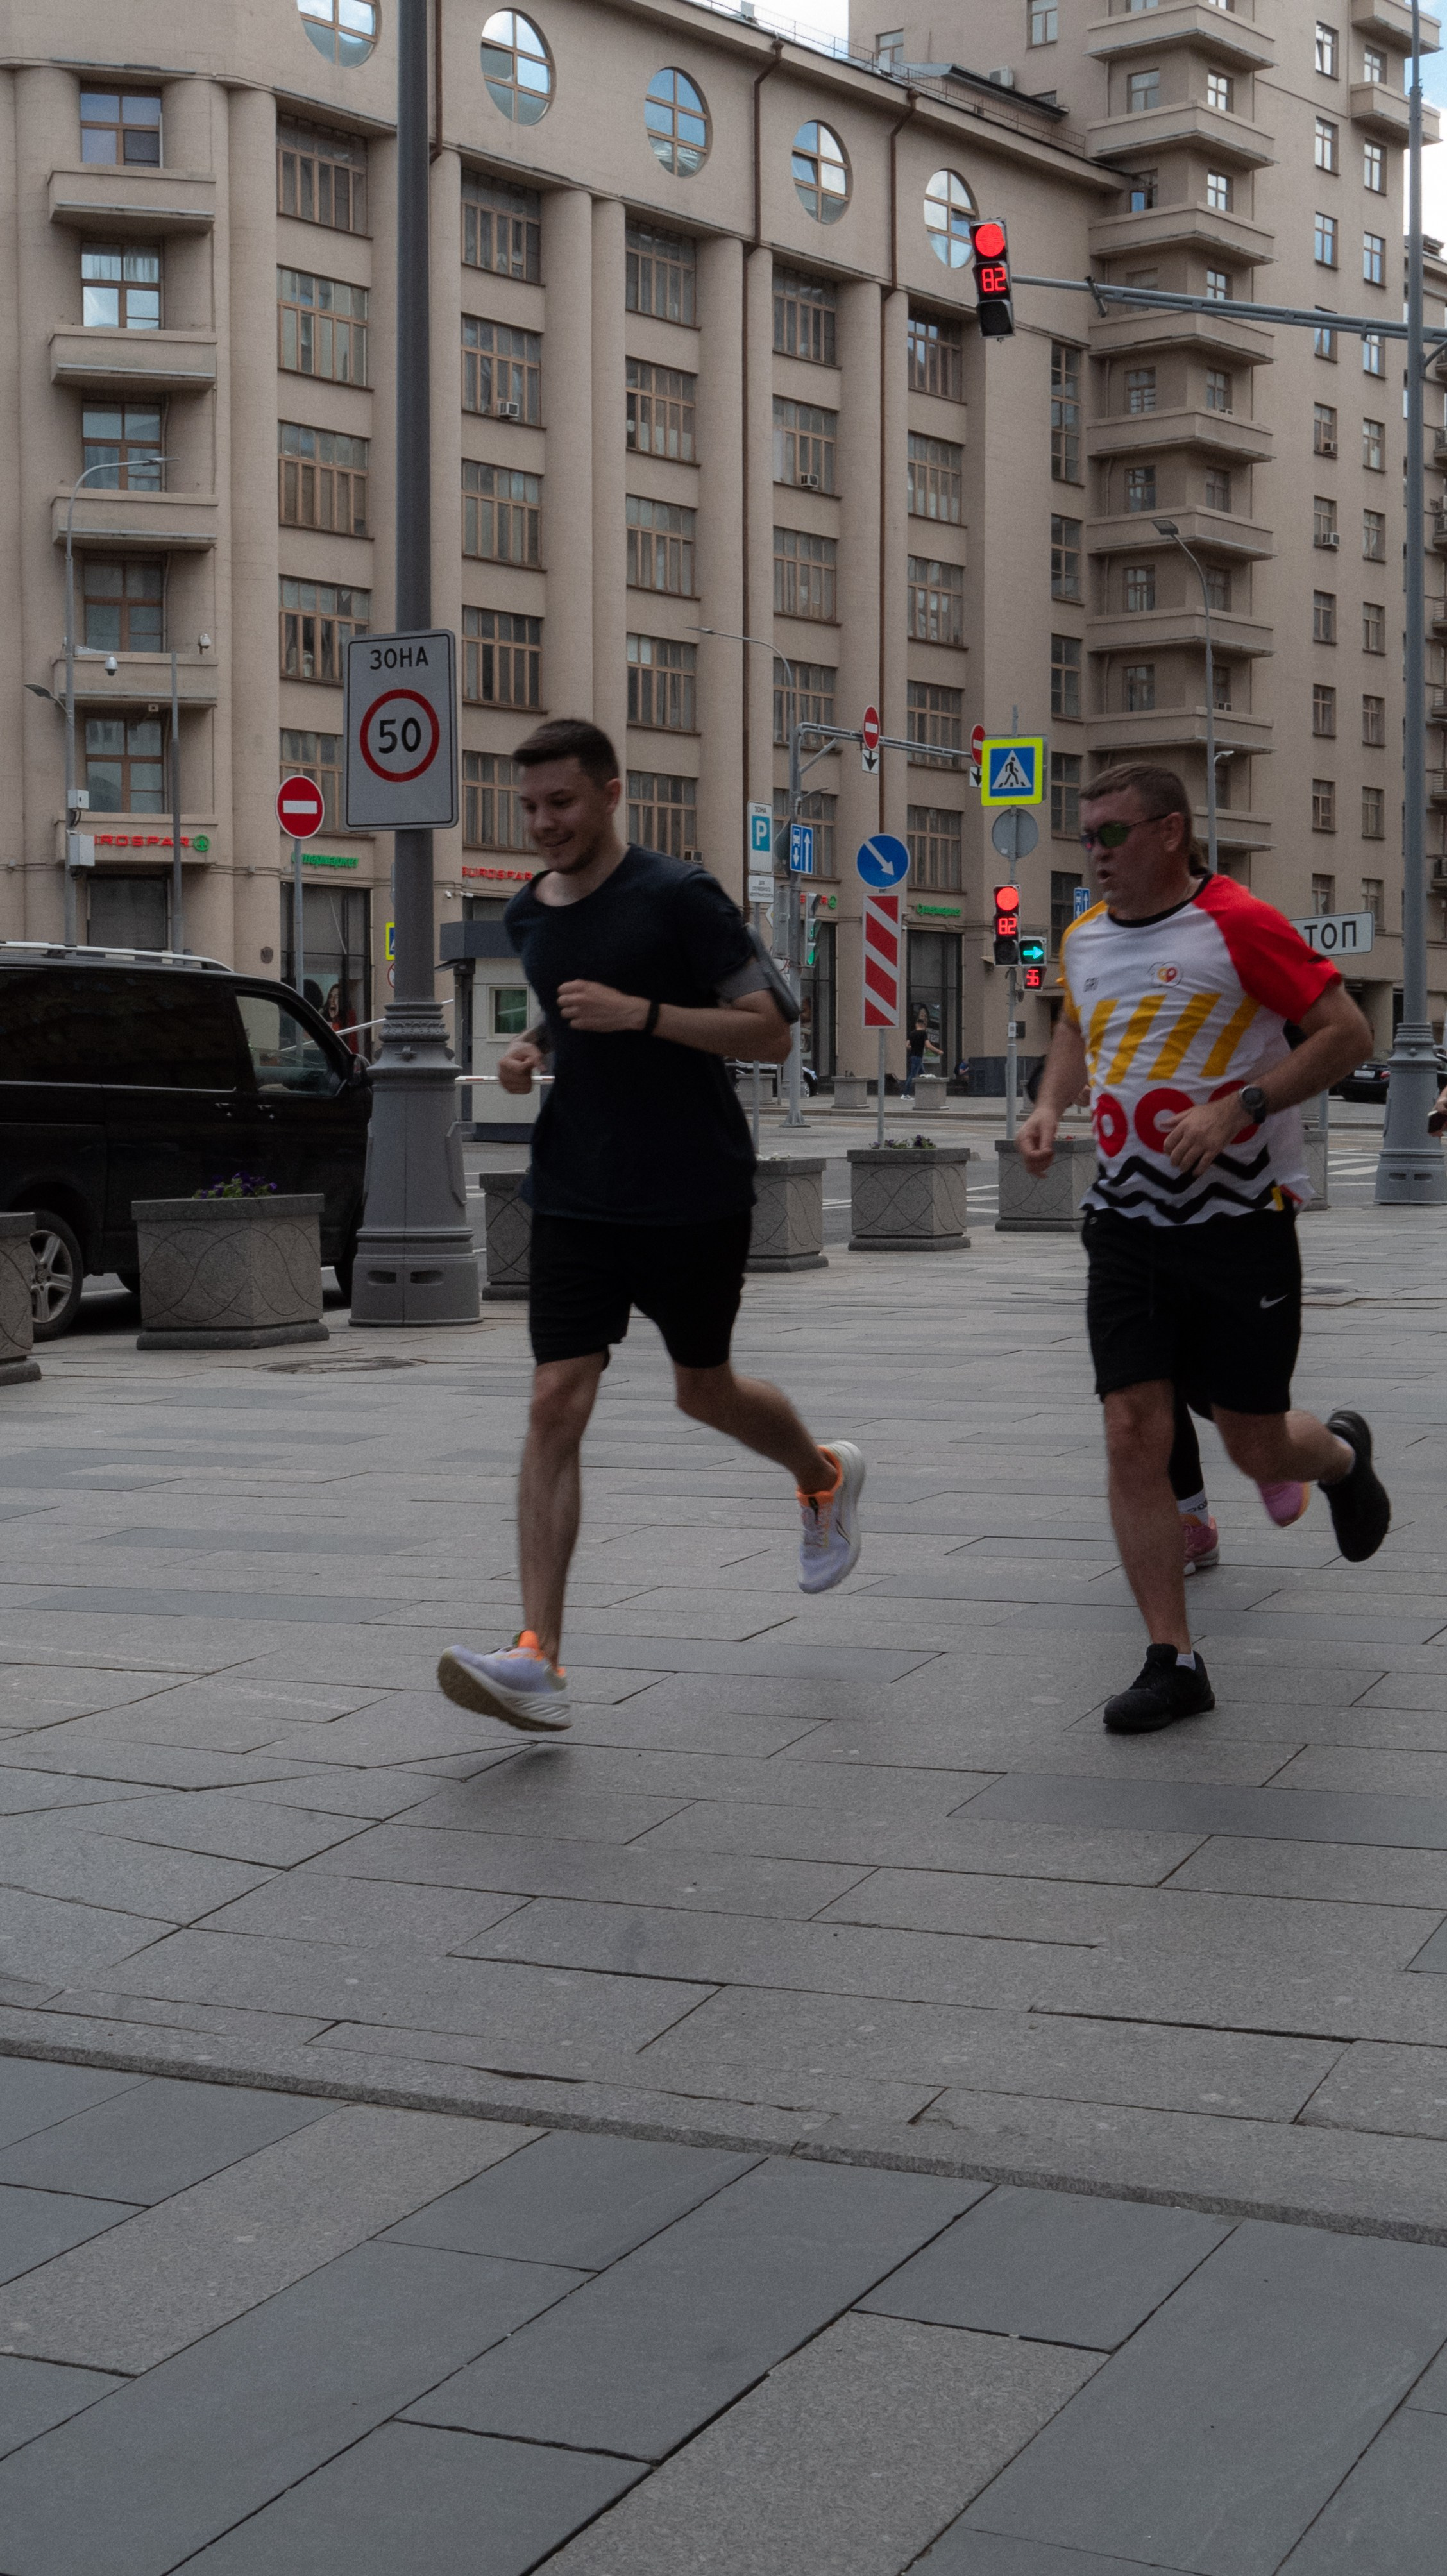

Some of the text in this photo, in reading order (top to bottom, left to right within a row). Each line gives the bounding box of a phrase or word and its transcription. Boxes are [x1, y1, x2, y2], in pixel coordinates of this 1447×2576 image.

[981, 267, 1006, 292] 82
[369, 646, 429, 670] ЗОНА
[378, 717, 421, 754] 50
[754, 806, 767, 814] ЗОНА
[94, 835, 189, 847] ROSPAR
[756, 820, 768, 846] P
[999, 917, 1017, 935] 82
[1303, 920, 1357, 949] ТОП
